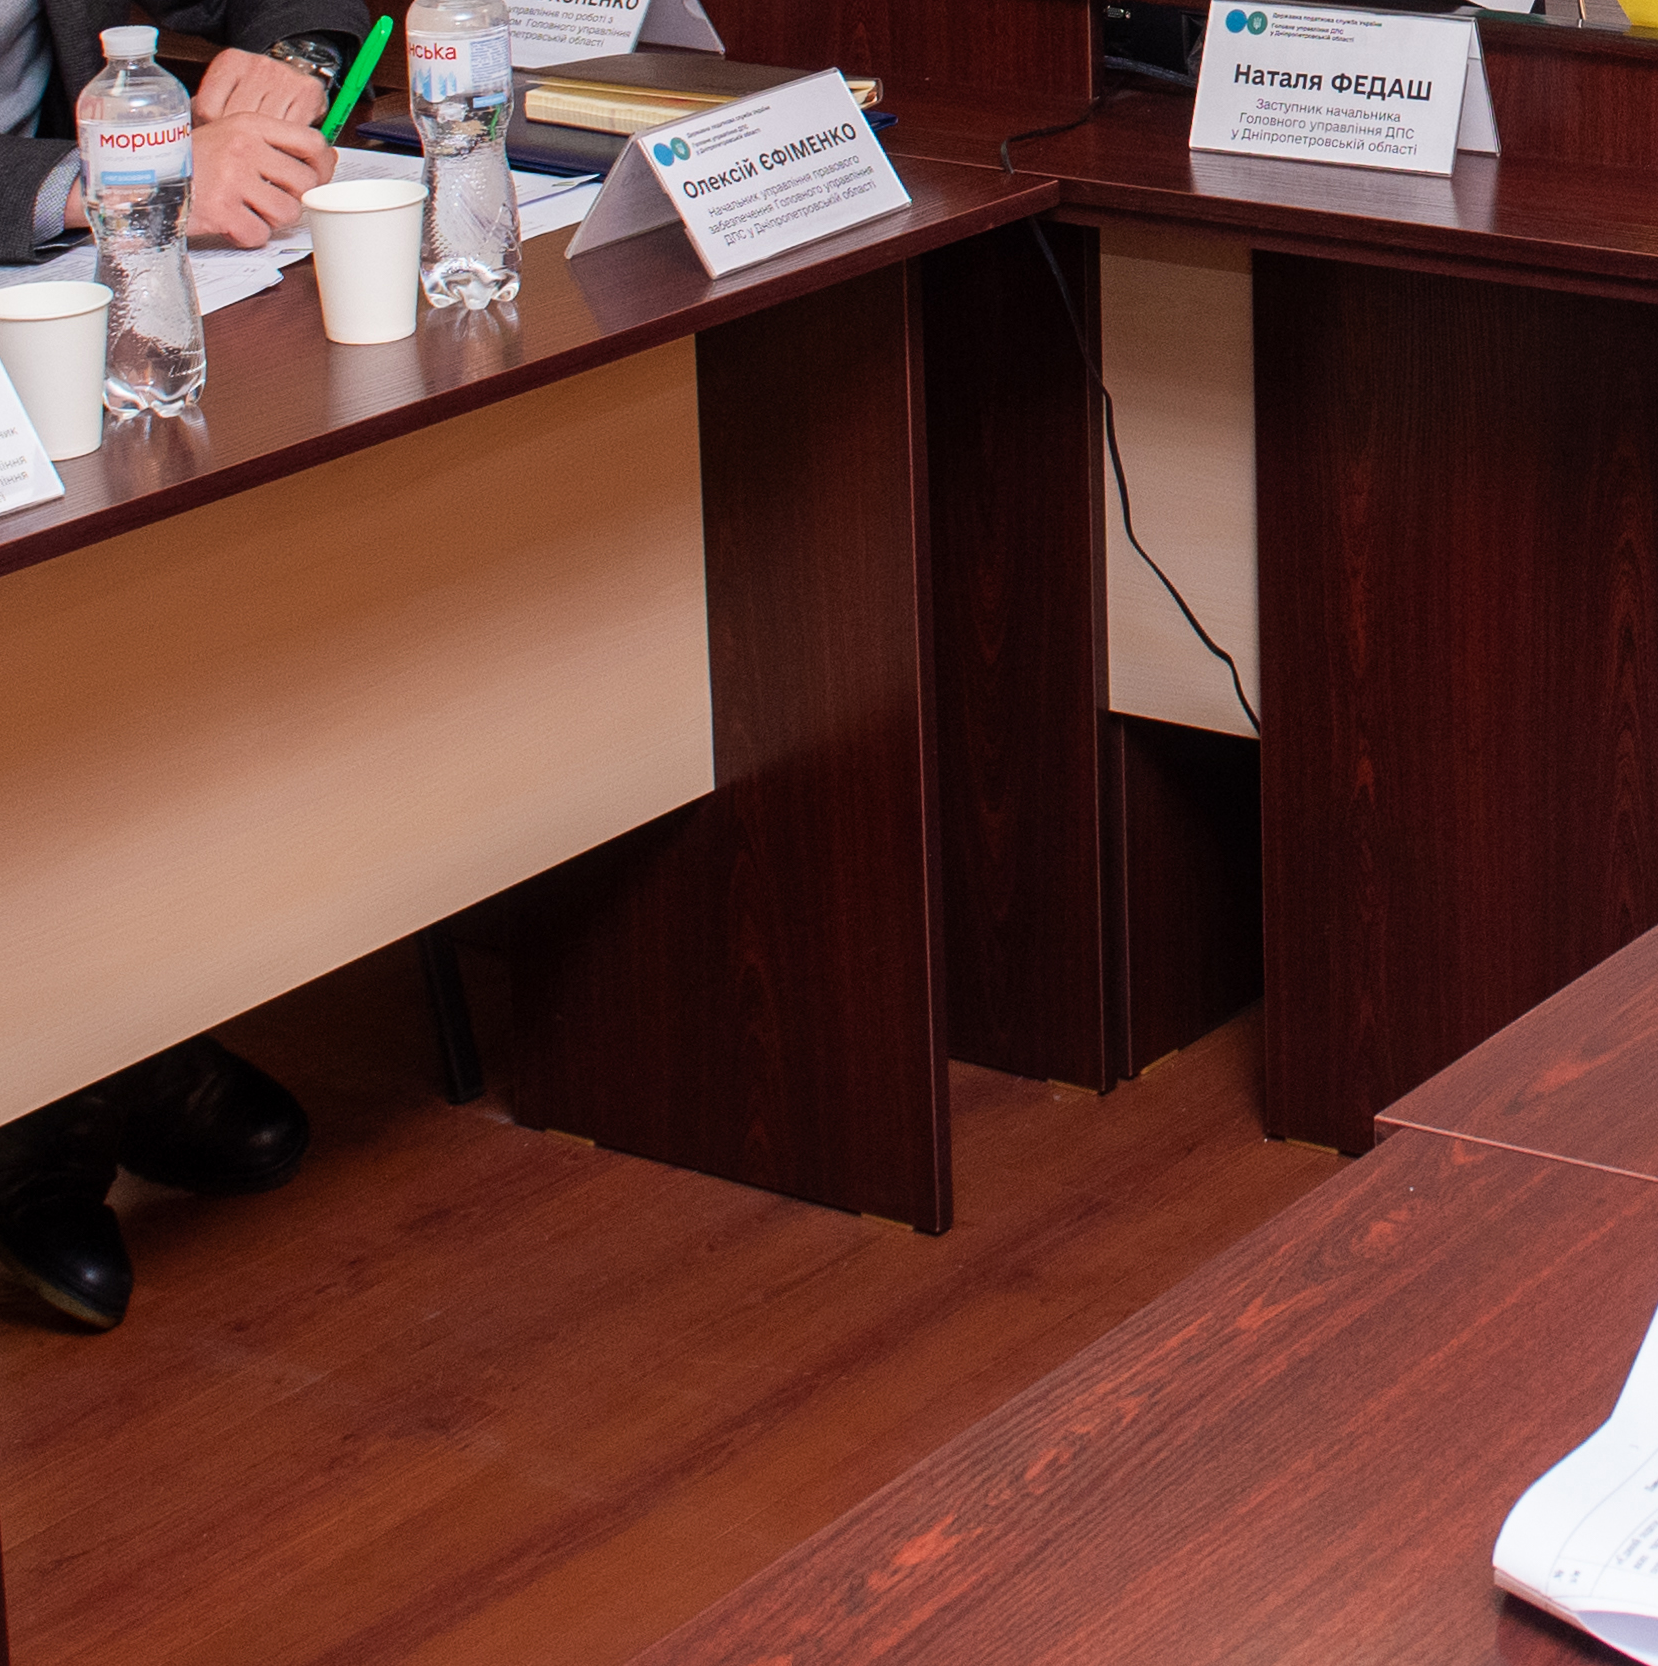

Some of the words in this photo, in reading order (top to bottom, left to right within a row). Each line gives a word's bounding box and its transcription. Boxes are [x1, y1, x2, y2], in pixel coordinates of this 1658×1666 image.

[1233, 62, 1323, 91] Наталя
[1330, 72, 1432, 101] ФЕДАШ
[1238, 111, 1306, 129] Головного
[1308, 120, 1382, 136] управління
[1384, 125, 1415, 140] ДПС
[1255, 97, 1322, 114] Заступник
[1325, 106, 1400, 122] начальника
[100, 122, 191, 152] моршинс
[1230, 128, 1239, 140] у
[1240, 127, 1365, 150] Дніпропетровській
[1367, 140, 1417, 155] області
[682, 157, 758, 199] Олексій
[758, 122, 856, 171] ЄФІМЕНКО
[707, 203, 773, 235] забезпечення
[772, 184, 823, 209] Головного
[822, 165, 873, 193] управління
[708, 192, 759, 217] Начальник
[762, 172, 813, 201] управління
[811, 154, 859, 178] правового
[723, 228, 747, 246] ДПС
[746, 227, 754, 238] у
[841, 180, 876, 200] області
